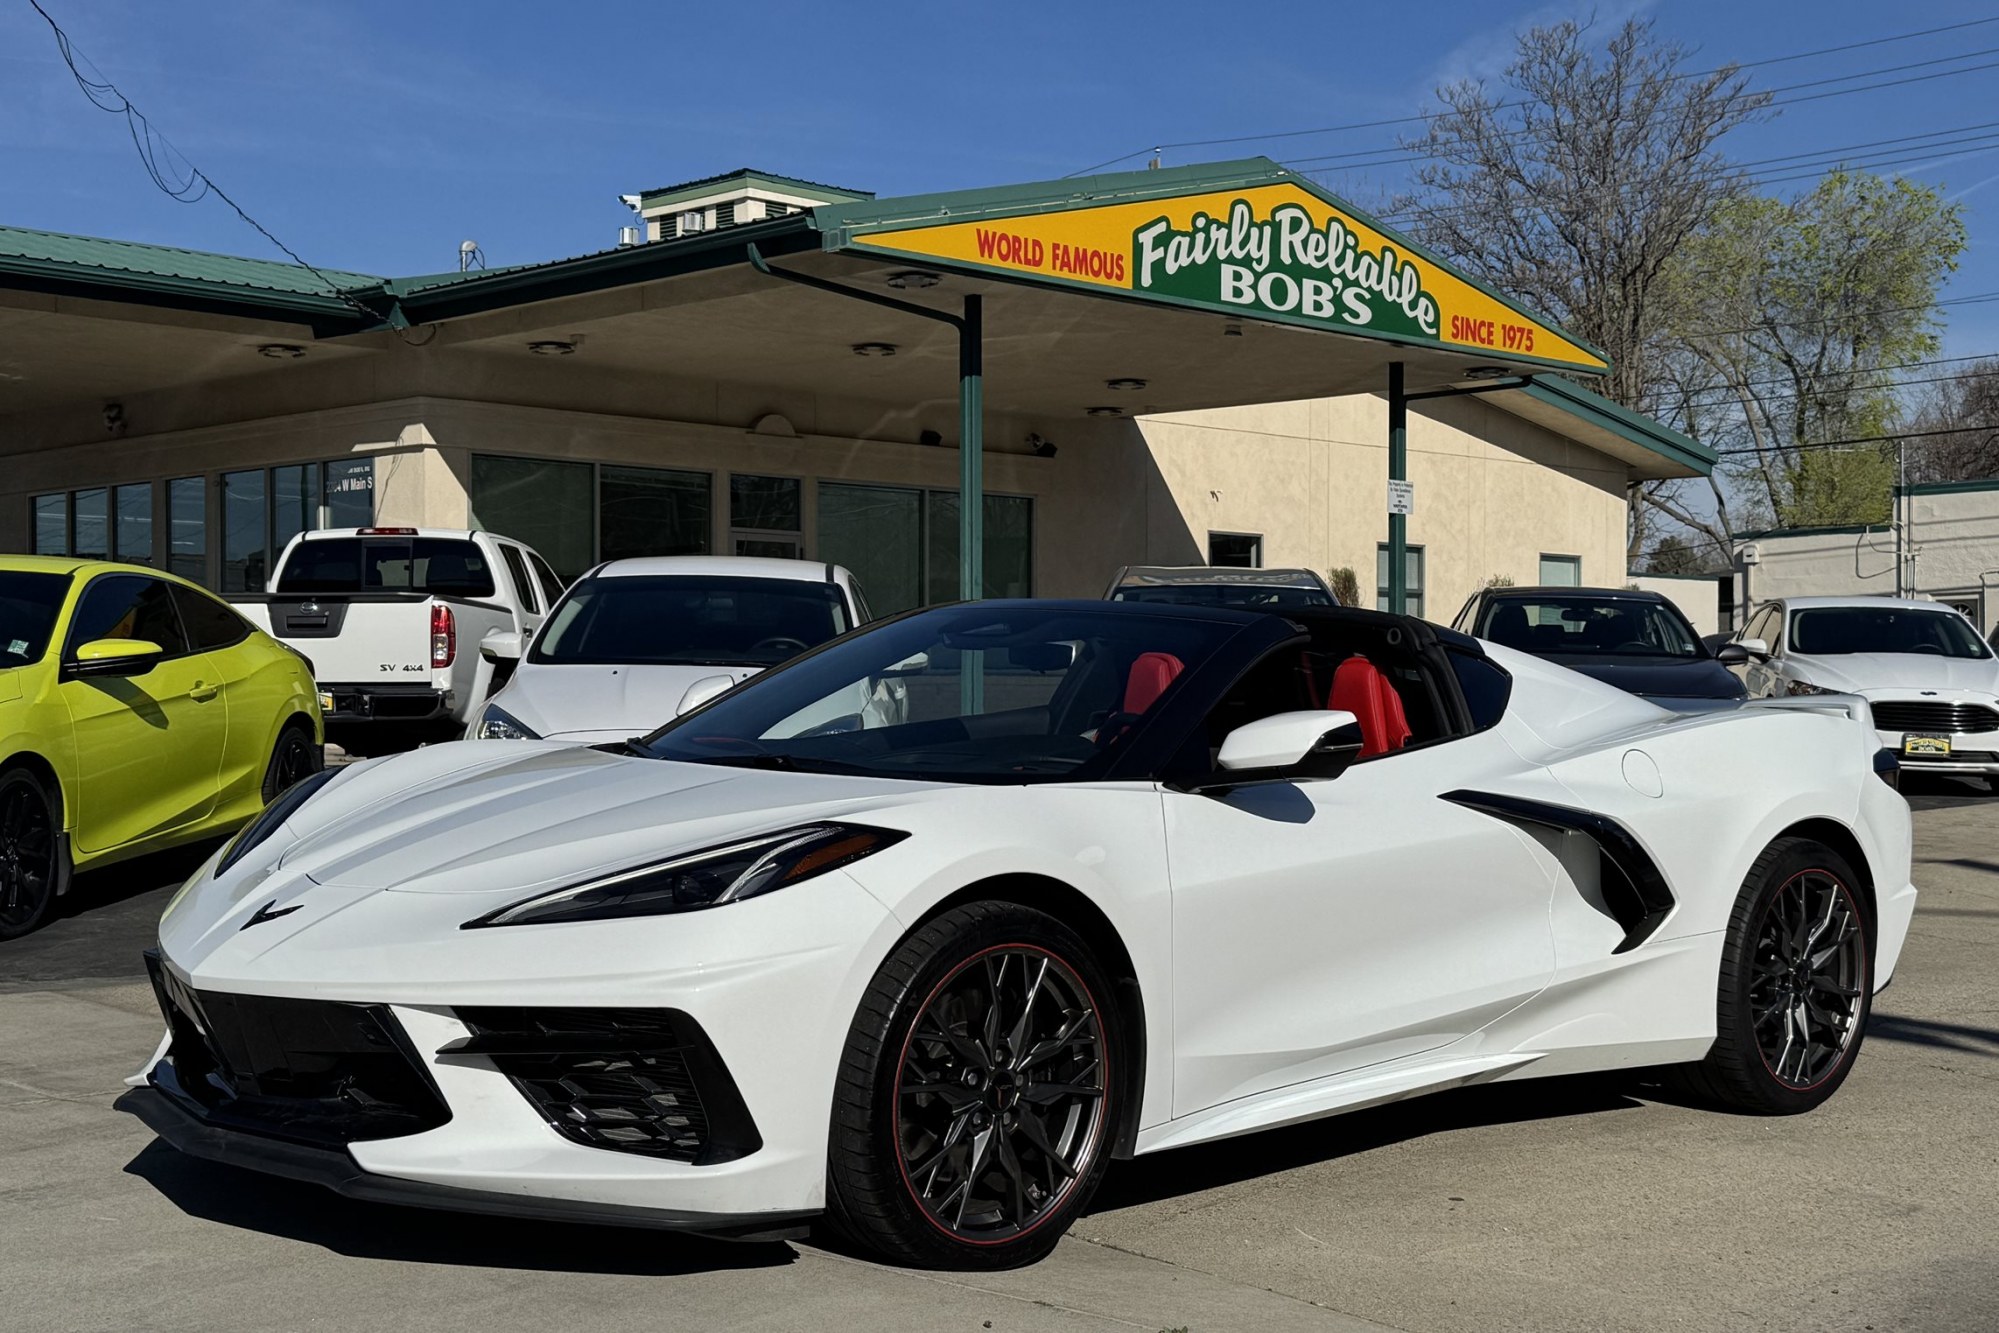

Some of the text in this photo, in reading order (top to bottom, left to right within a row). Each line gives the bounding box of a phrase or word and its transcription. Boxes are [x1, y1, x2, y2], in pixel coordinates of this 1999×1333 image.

[975, 227, 1125, 280] WORLD FAMOUS
[1138, 203, 1437, 335] Fairly Reliable
[1220, 263, 1373, 325] BOB'S
[1451, 314, 1534, 353] SINCE 1975
[342, 478, 349, 492] W
[350, 477, 366, 491] Main
[380, 663, 396, 671] SV
